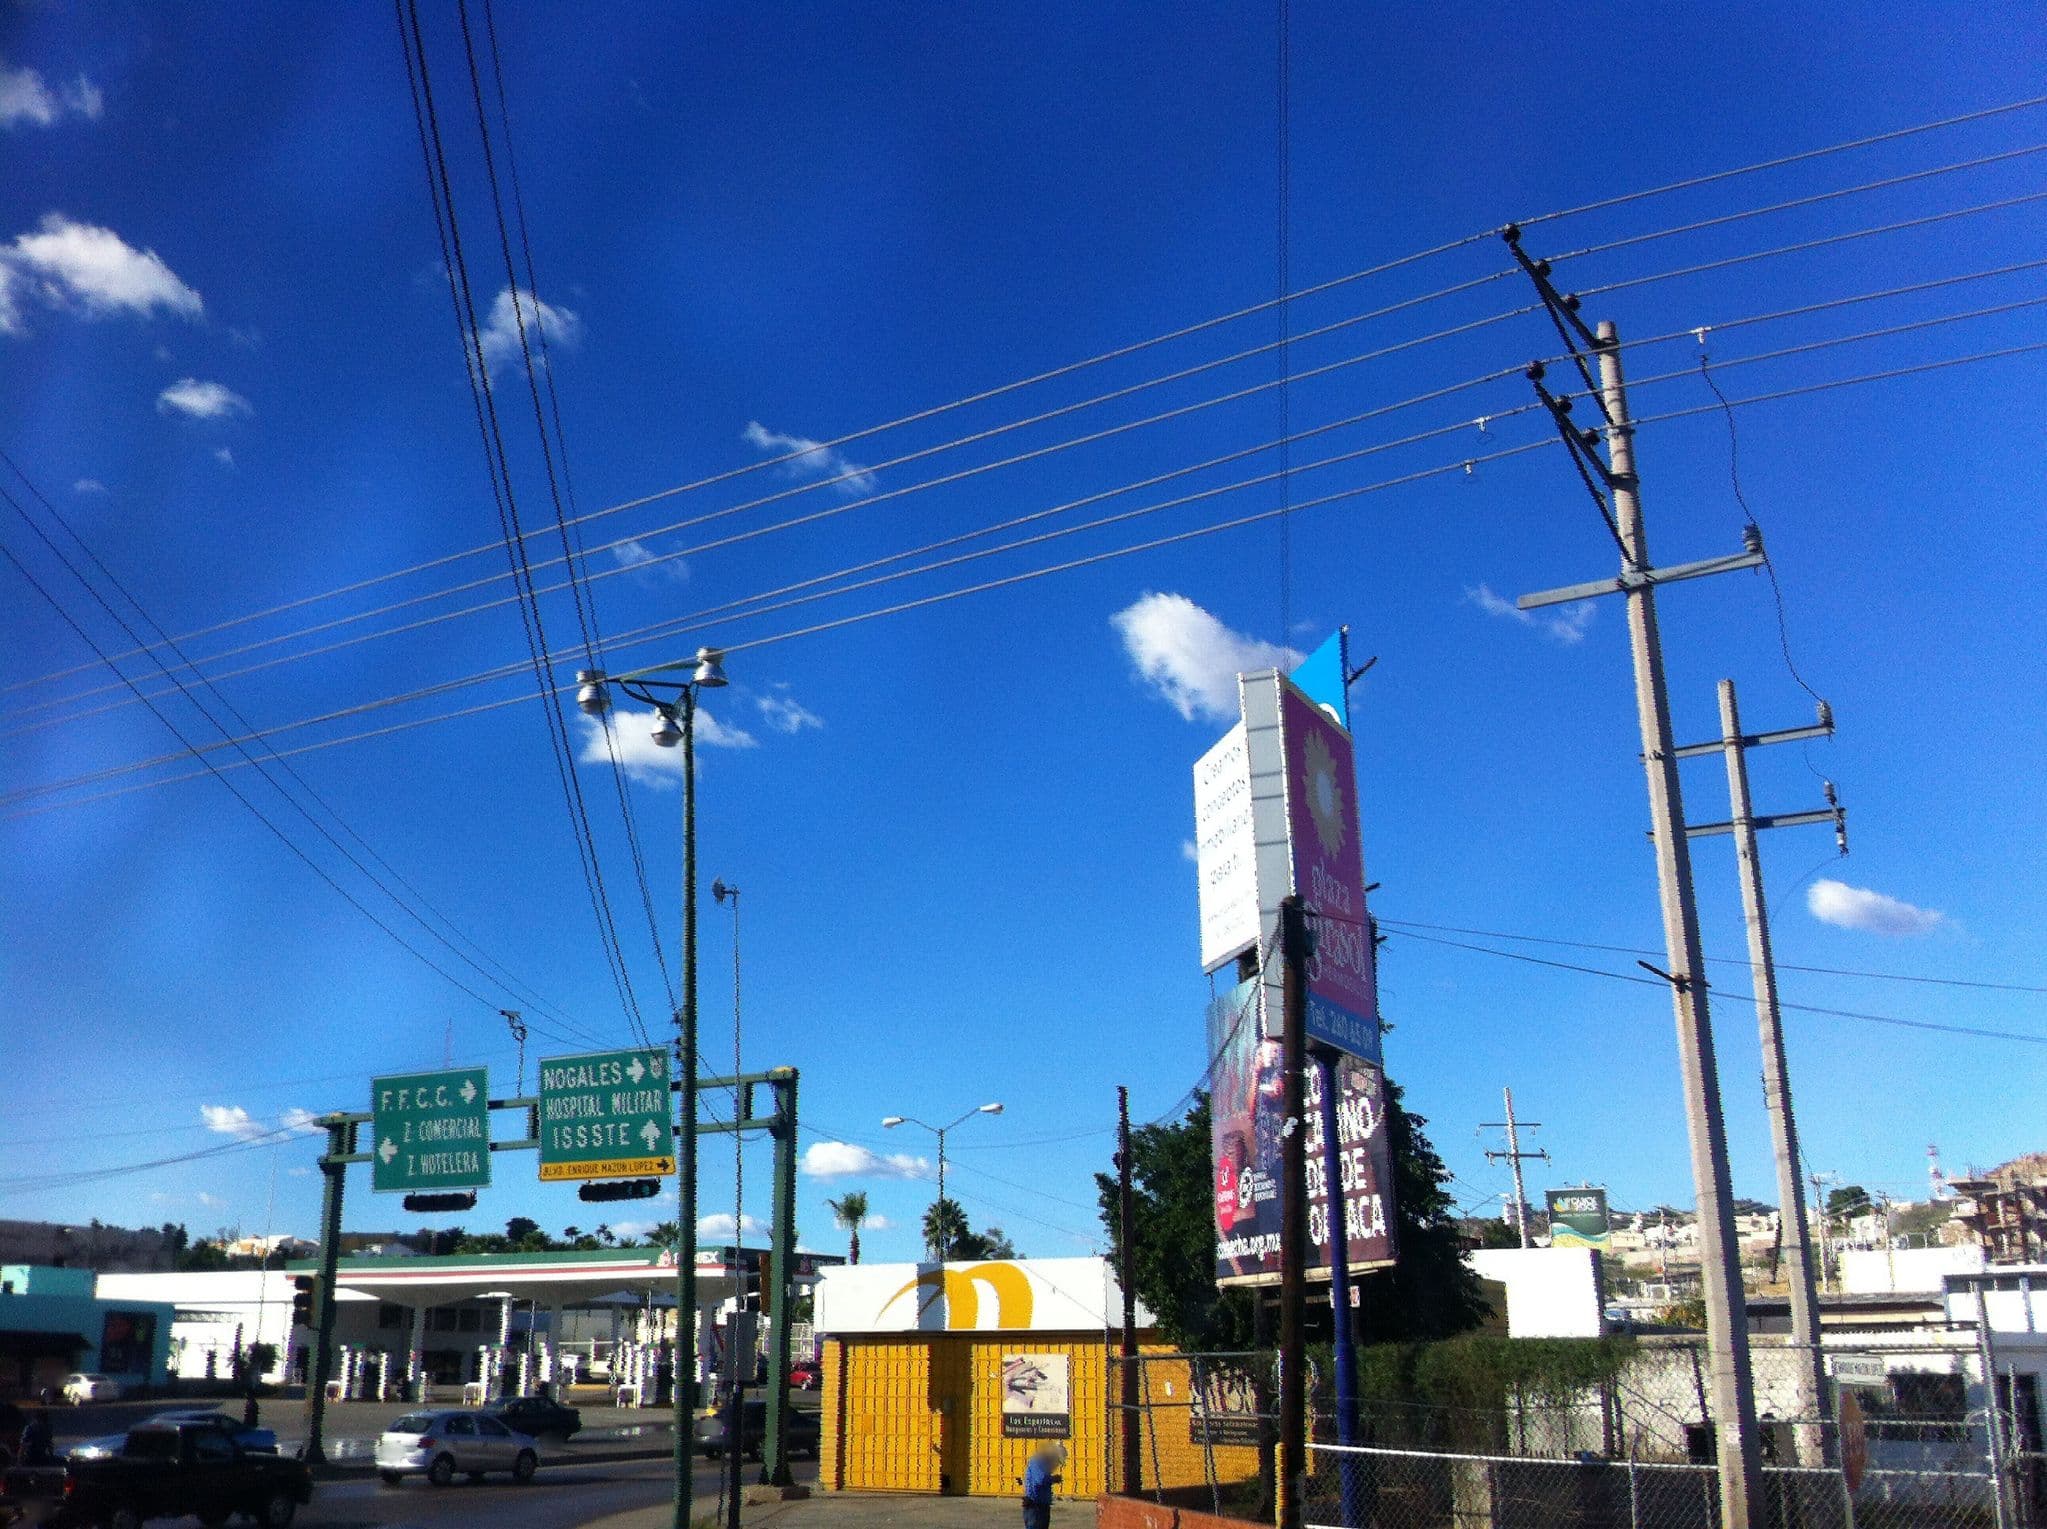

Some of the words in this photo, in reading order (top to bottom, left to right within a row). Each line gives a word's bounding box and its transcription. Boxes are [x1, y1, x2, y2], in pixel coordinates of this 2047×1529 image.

[543, 1061, 623, 1090] NOGALES
[546, 1094, 604, 1120] HOSPITAL
[611, 1089, 663, 1115] MILITAR
[418, 1116, 482, 1141] COMERCIAL
[553, 1122, 630, 1149] ISSSTE
[420, 1151, 479, 1176] HOTELERA
[567, 1163, 599, 1176] ENRIQUE
